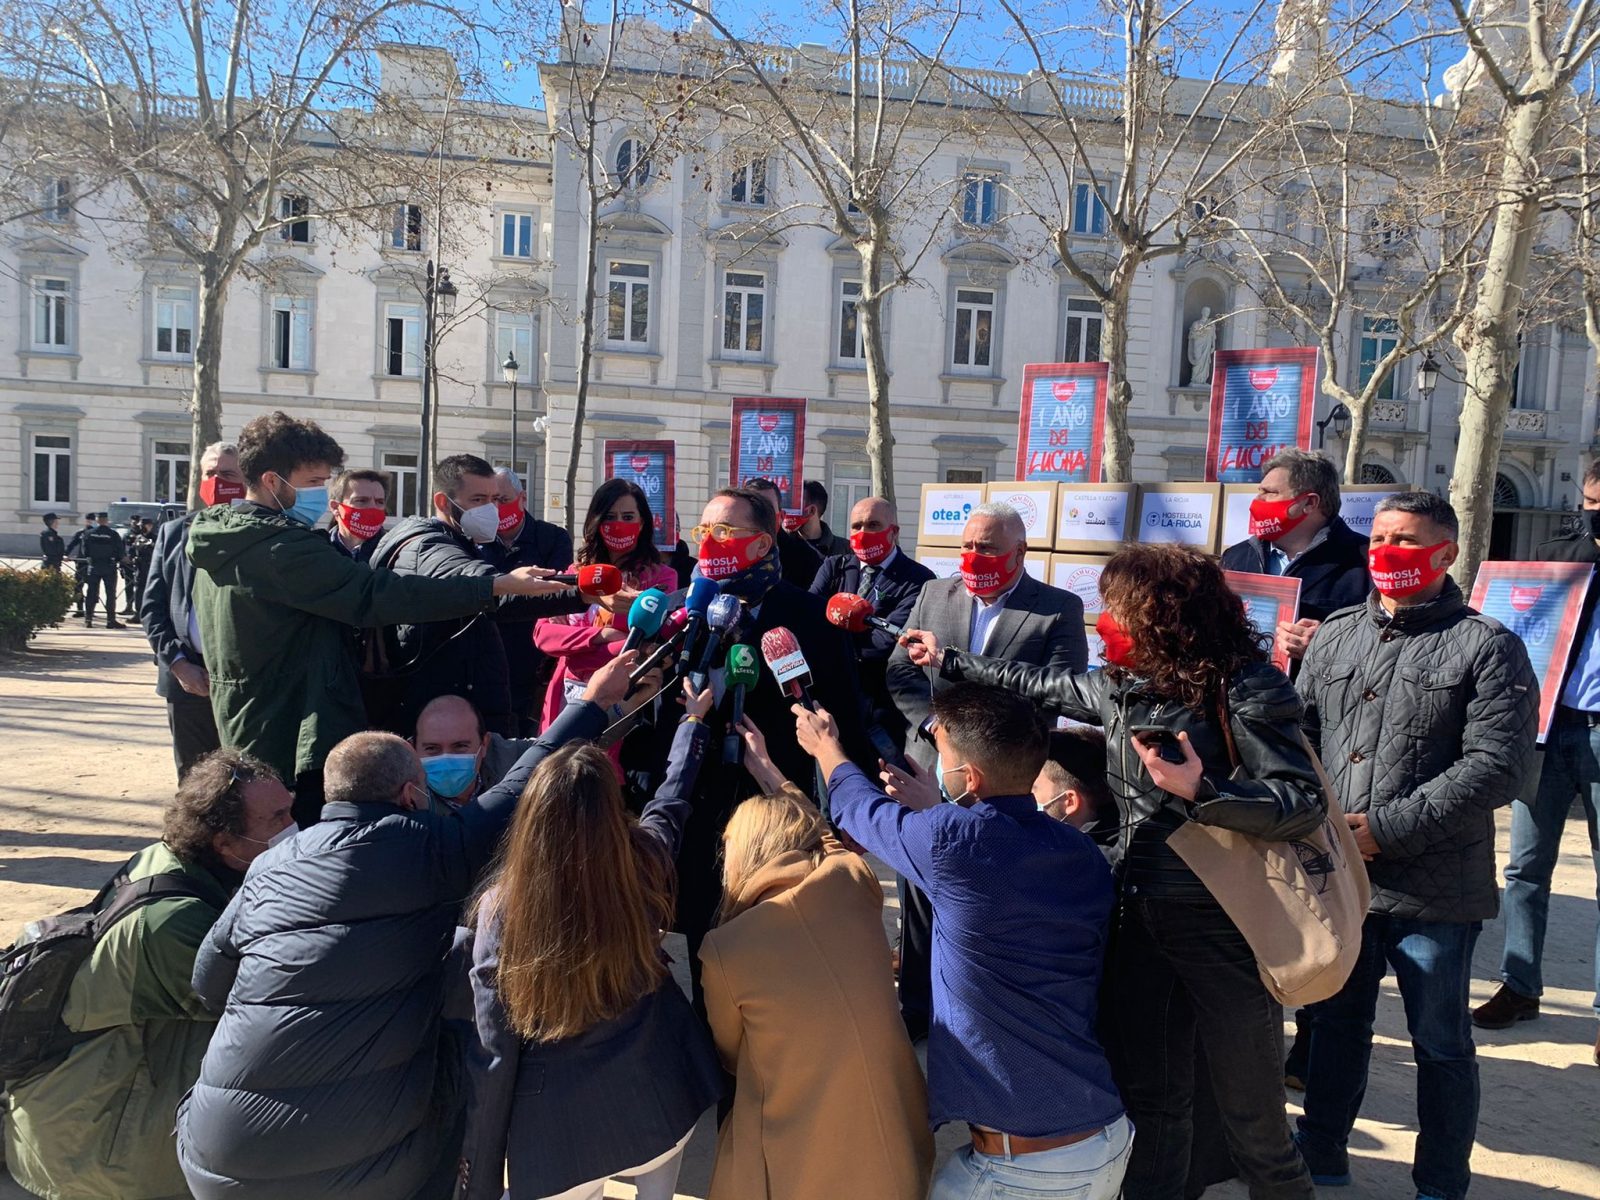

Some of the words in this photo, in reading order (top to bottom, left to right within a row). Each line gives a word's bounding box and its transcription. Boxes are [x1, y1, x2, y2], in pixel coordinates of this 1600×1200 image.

[1050, 401, 1087, 430] AÑO
[1246, 390, 1290, 423] AÑO
[757, 432, 788, 458] AÑO
[1028, 449, 1086, 475] LUCHA
[932, 508, 961, 521] otea
[640, 595, 659, 613] G
